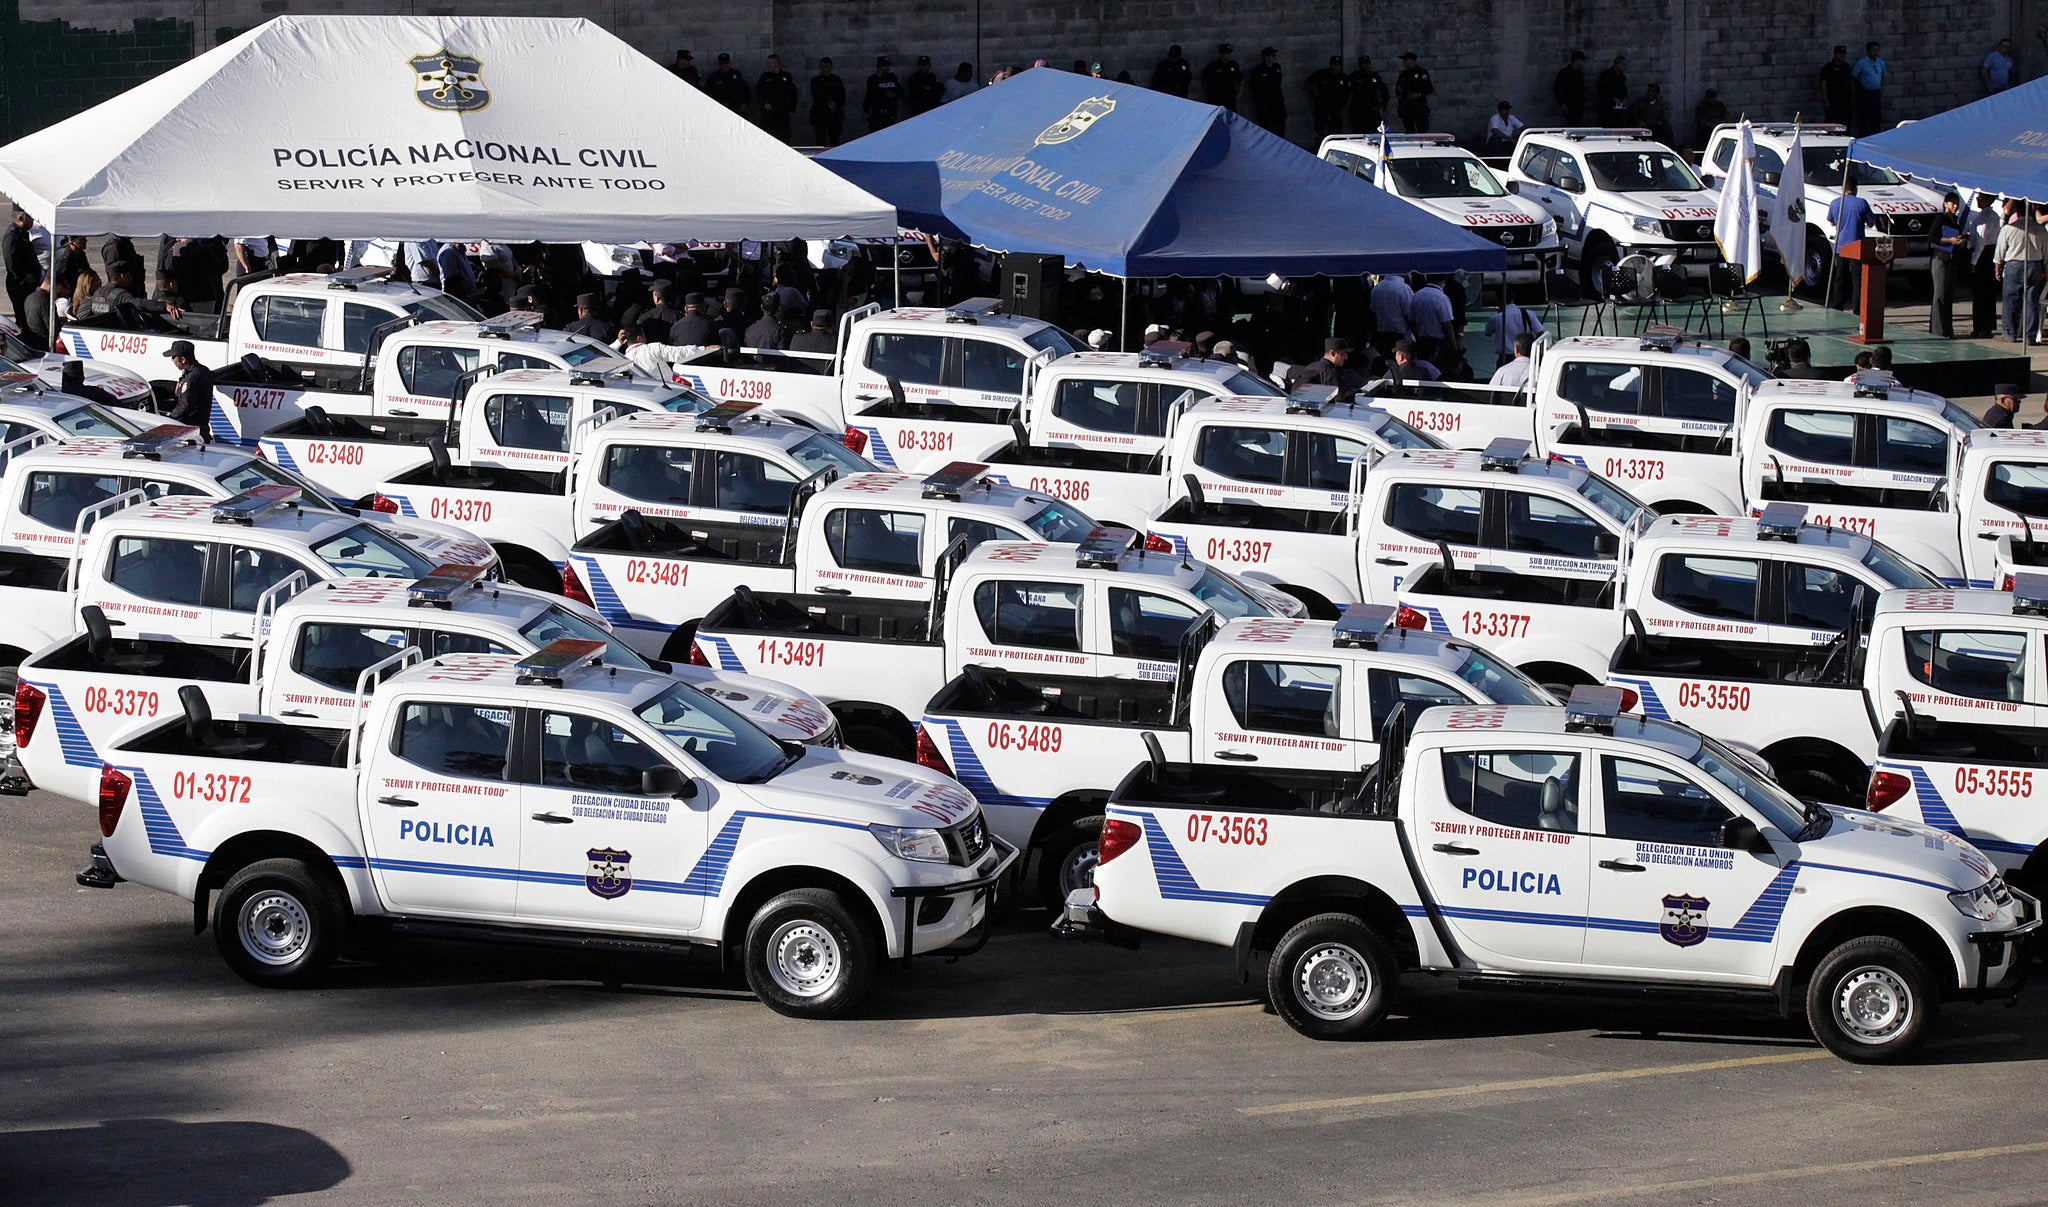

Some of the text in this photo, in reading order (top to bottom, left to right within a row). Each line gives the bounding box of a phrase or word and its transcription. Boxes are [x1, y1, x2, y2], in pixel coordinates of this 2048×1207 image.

[274, 139, 657, 167] POLICÍA NACIONAL CIVIL
[278, 172, 665, 190] SERVIR Y PROTEGER ANTE TODO
[1055, 180, 1103, 205] CIVIL
[1000, 192, 1072, 221] ANTE TODO
[1464, 213, 1535, 225] 03-3388
[101, 335, 148, 355] 04-3495
[233, 388, 285, 410] 02-3477
[720, 378, 771, 400] 01-3398
[1408, 411, 1461, 431] 05-3391
[898, 429, 953, 451] 08-3381
[1074, 434, 1102, 442] PROTEGER
[308, 443, 363, 465] 02-3480
[508, 451, 538, 459] PROTEGER
[1605, 457, 1664, 480] 01-3373
[1031, 477, 1089, 501] 03-3386
[1219, 484, 1249, 493] PROTEGER
[431, 497, 491, 522] 01-3370
[593, 503, 617, 511] "SERVIR
[623, 506, 654, 514] PROTEGER
[1980, 519, 2005, 527] "SERVIR
[12, 533, 37, 541] "SERVIR
[1207, 538, 1272, 563] 01-3397
[1377, 543, 1403, 552] "SERVIR
[1460, 551, 1480, 559] TODO"
[627, 559, 688, 587] 02-3481
[1544, 559, 1578, 568] DIRECCION
[816, 570, 843, 579] "SERVIR
[850, 574, 885, 584] PROTEGER
[886, 578, 903, 586] ANTE
[906, 580, 927, 588] TODO"
[93, 601, 121, 611] "SERVIR
[128, 605, 161, 615] PROTEGER
[162, 609, 179, 617] ANTE
[181, 610, 202, 619] TODO"
[1462, 611, 1530, 637] 13-3377
[1646, 618, 1673, 627] "SERVIR
[1681, 621, 1715, 631] PROTEGER
[1717, 624, 1733, 632] ANTE
[1736, 626, 1757, 634] TODO"
[758, 640, 824, 667] 11-3491
[966, 648, 997, 657] "SERVIR
[1005, 651, 1043, 661] PROTEGER
[1044, 654, 1063, 662] ANTE
[1065, 656, 1089, 664] TODO"
[1137, 663, 1177, 673] DELEGACION
[85, 686, 159, 717] 08-3379
[283, 694, 312, 704] "SERVIR
[314, 696, 318, 704] Y
[1679, 682, 1750, 712] 05-3550
[1928, 695, 2022, 712] Y PROTEGER ANTE TODO"
[988, 722, 1062, 753] 06-3489
[1215, 732, 1347, 751] "SERVIR Y PROTEGER ANTE TODO"
[174, 771, 251, 803] 01-3372
[381, 778, 508, 797] "SERVIR Y PROTEGER ANTE TODO"
[1955, 767, 2033, 798] 05-3555
[572, 795, 670, 812] DELEGACION CIUDAD DELGADO
[572, 807, 666, 823] SUB DELEGACION DE CIUDAD DELGADO
[400, 817, 495, 848] POLICIA
[1187, 814, 1268, 846] 07-3563
[1431, 822, 1576, 844] "SERVIR Y PROTEGER ANTE TODO"
[1636, 843, 1734, 859] DELEGACION DE LA UNION
[1636, 853, 1733, 870] SUB DELEGACION ANAMOROS
[1462, 867, 1562, 896] POLICIA
